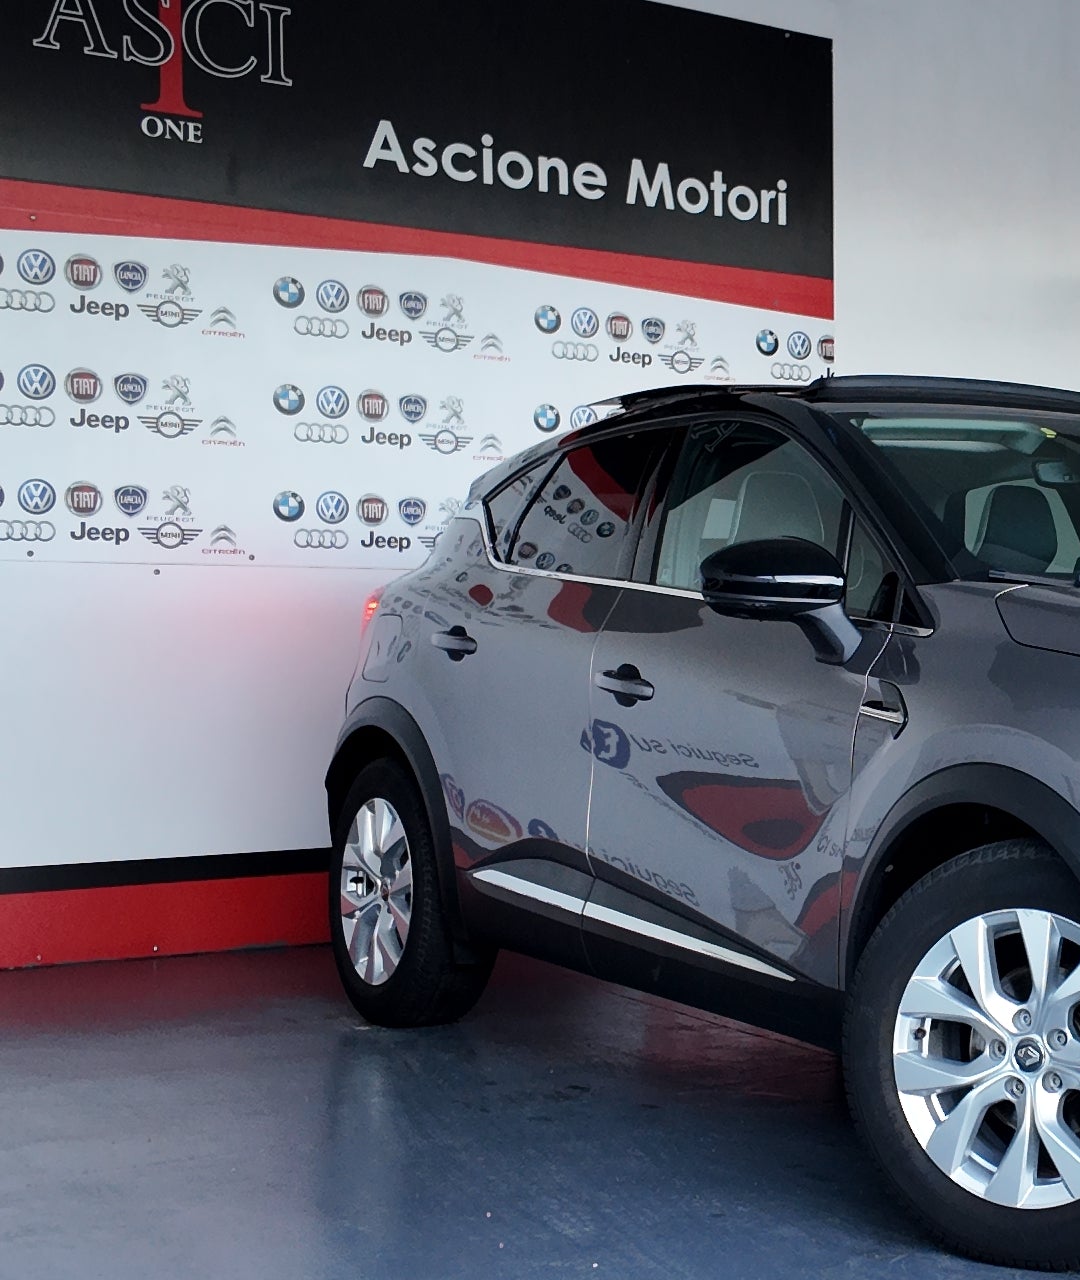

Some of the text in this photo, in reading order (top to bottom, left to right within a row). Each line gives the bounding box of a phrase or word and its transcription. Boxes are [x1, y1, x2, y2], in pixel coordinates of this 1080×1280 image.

[141, 116, 203, 144] ONE
[363, 120, 787, 226] Ascione Motori
[73, 264, 95, 282] FIAT
[70, 295, 130, 320] Jeep
[361, 322, 412, 346] Jeep
[609, 347, 653, 368] Jeep
[73, 378, 95, 395] FIAT
[70, 409, 129, 433] Jeep
[361, 427, 412, 449] Jeep
[73, 492, 95, 508] FIAT
[70, 522, 130, 545] Jeep
[360, 531, 411, 553] Jeep
